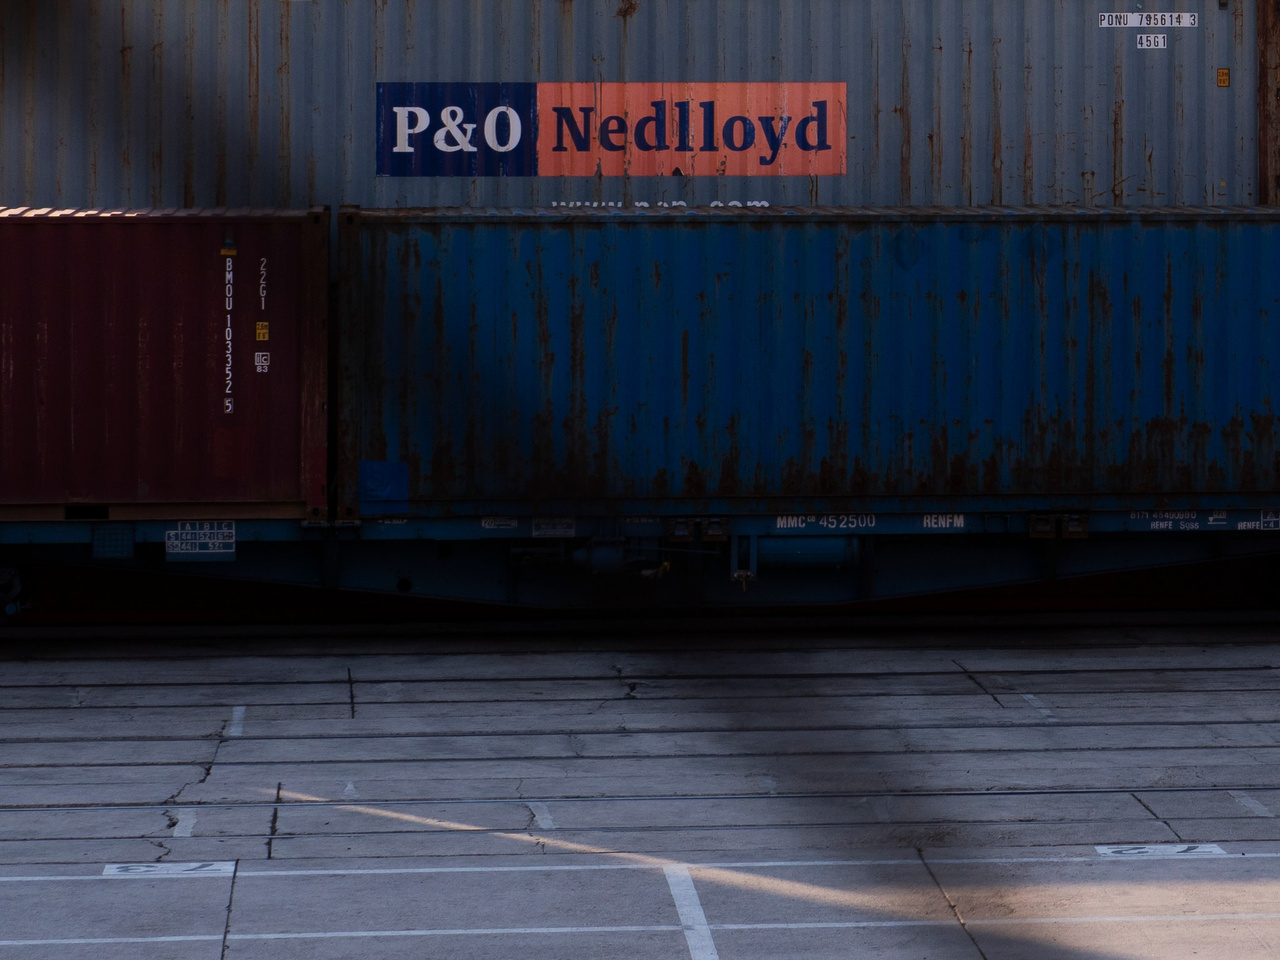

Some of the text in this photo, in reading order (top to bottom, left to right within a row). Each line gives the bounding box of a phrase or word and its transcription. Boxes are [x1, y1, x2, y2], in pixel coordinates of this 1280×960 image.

[1099, 14, 1196, 25] PONU 795614 3
[393, 100, 832, 167] P&O Nedlloyd
[225, 257, 234, 310] BMOU
[259, 257, 267, 310] 22G1
[225, 314, 233, 393] 103352
[256, 365, 268, 373] 83
[1150, 521, 1200, 530] RENFE Sgss
